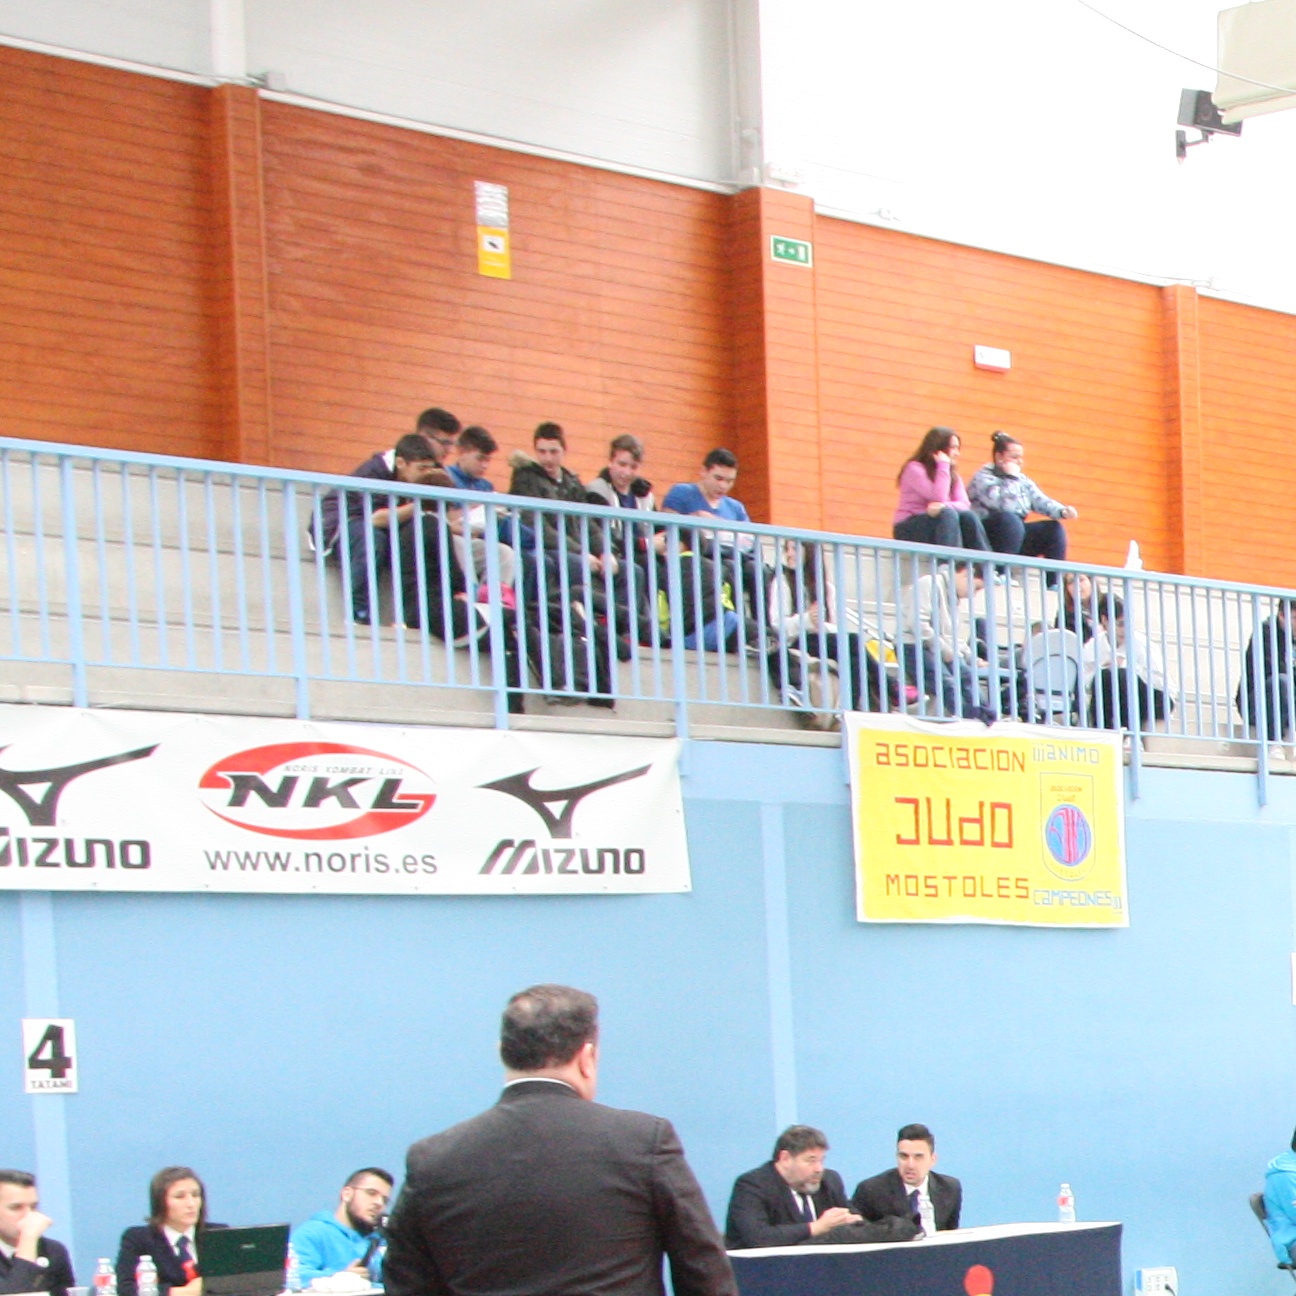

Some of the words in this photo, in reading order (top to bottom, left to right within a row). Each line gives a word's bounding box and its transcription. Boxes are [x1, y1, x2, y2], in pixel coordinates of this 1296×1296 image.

[226, 774, 421, 810] NKL
[203, 846, 438, 875] www.noris.es
[478, 838, 646, 875] MIZUNO
[886, 874, 1029, 898] MOSTOLES
[28, 1024, 73, 1078] 4
